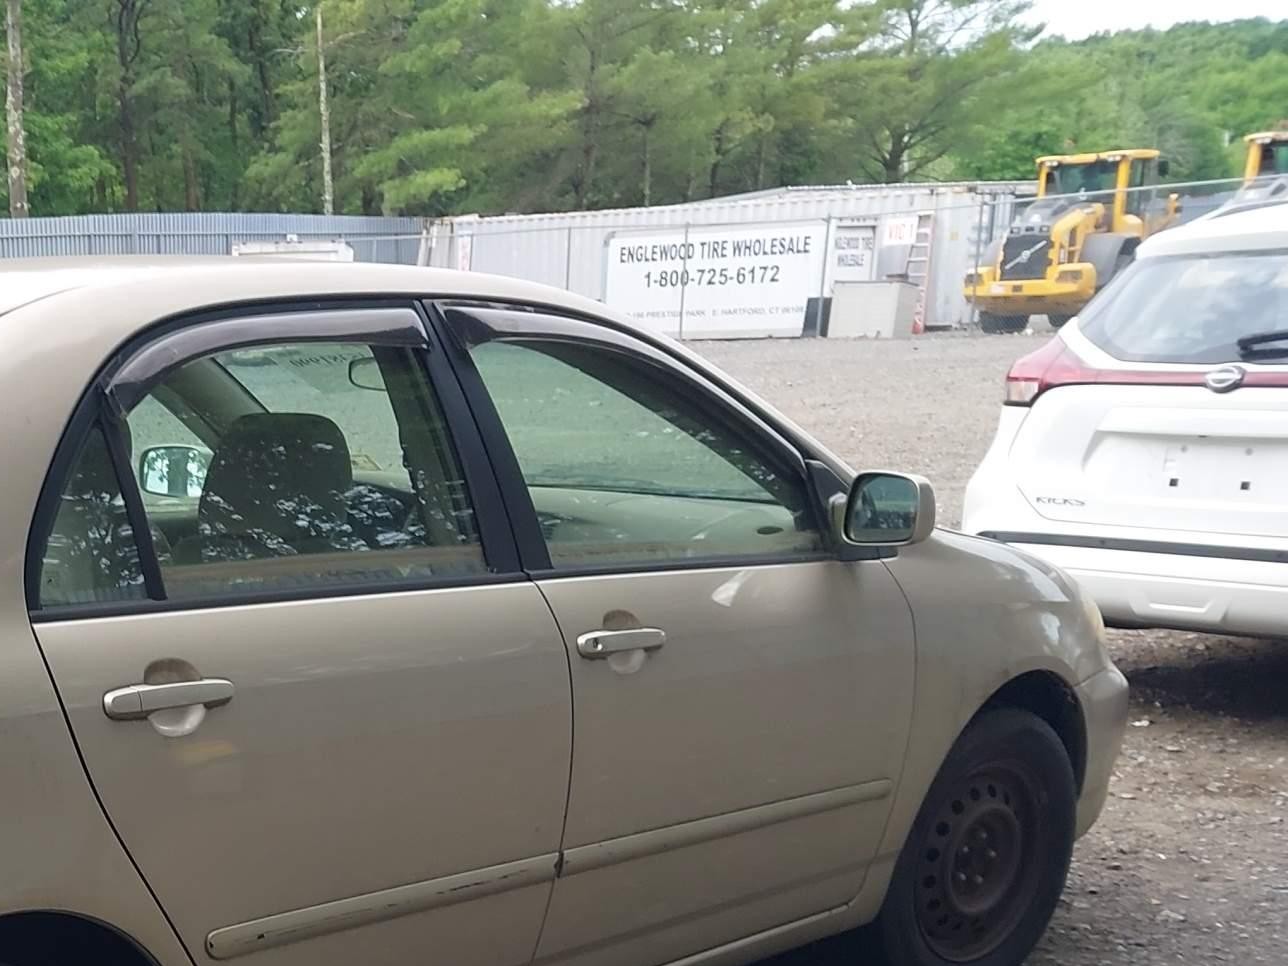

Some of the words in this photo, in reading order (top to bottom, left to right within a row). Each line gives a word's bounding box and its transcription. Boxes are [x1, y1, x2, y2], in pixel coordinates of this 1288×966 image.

[620, 243, 695, 264] ENGLEWOOD
[700, 240, 728, 259] TIRE
[732, 236, 812, 257] WHOLESALE
[644, 265, 780, 288] 1-800-725-6172
[1036, 496, 1086, 506] KICKS
